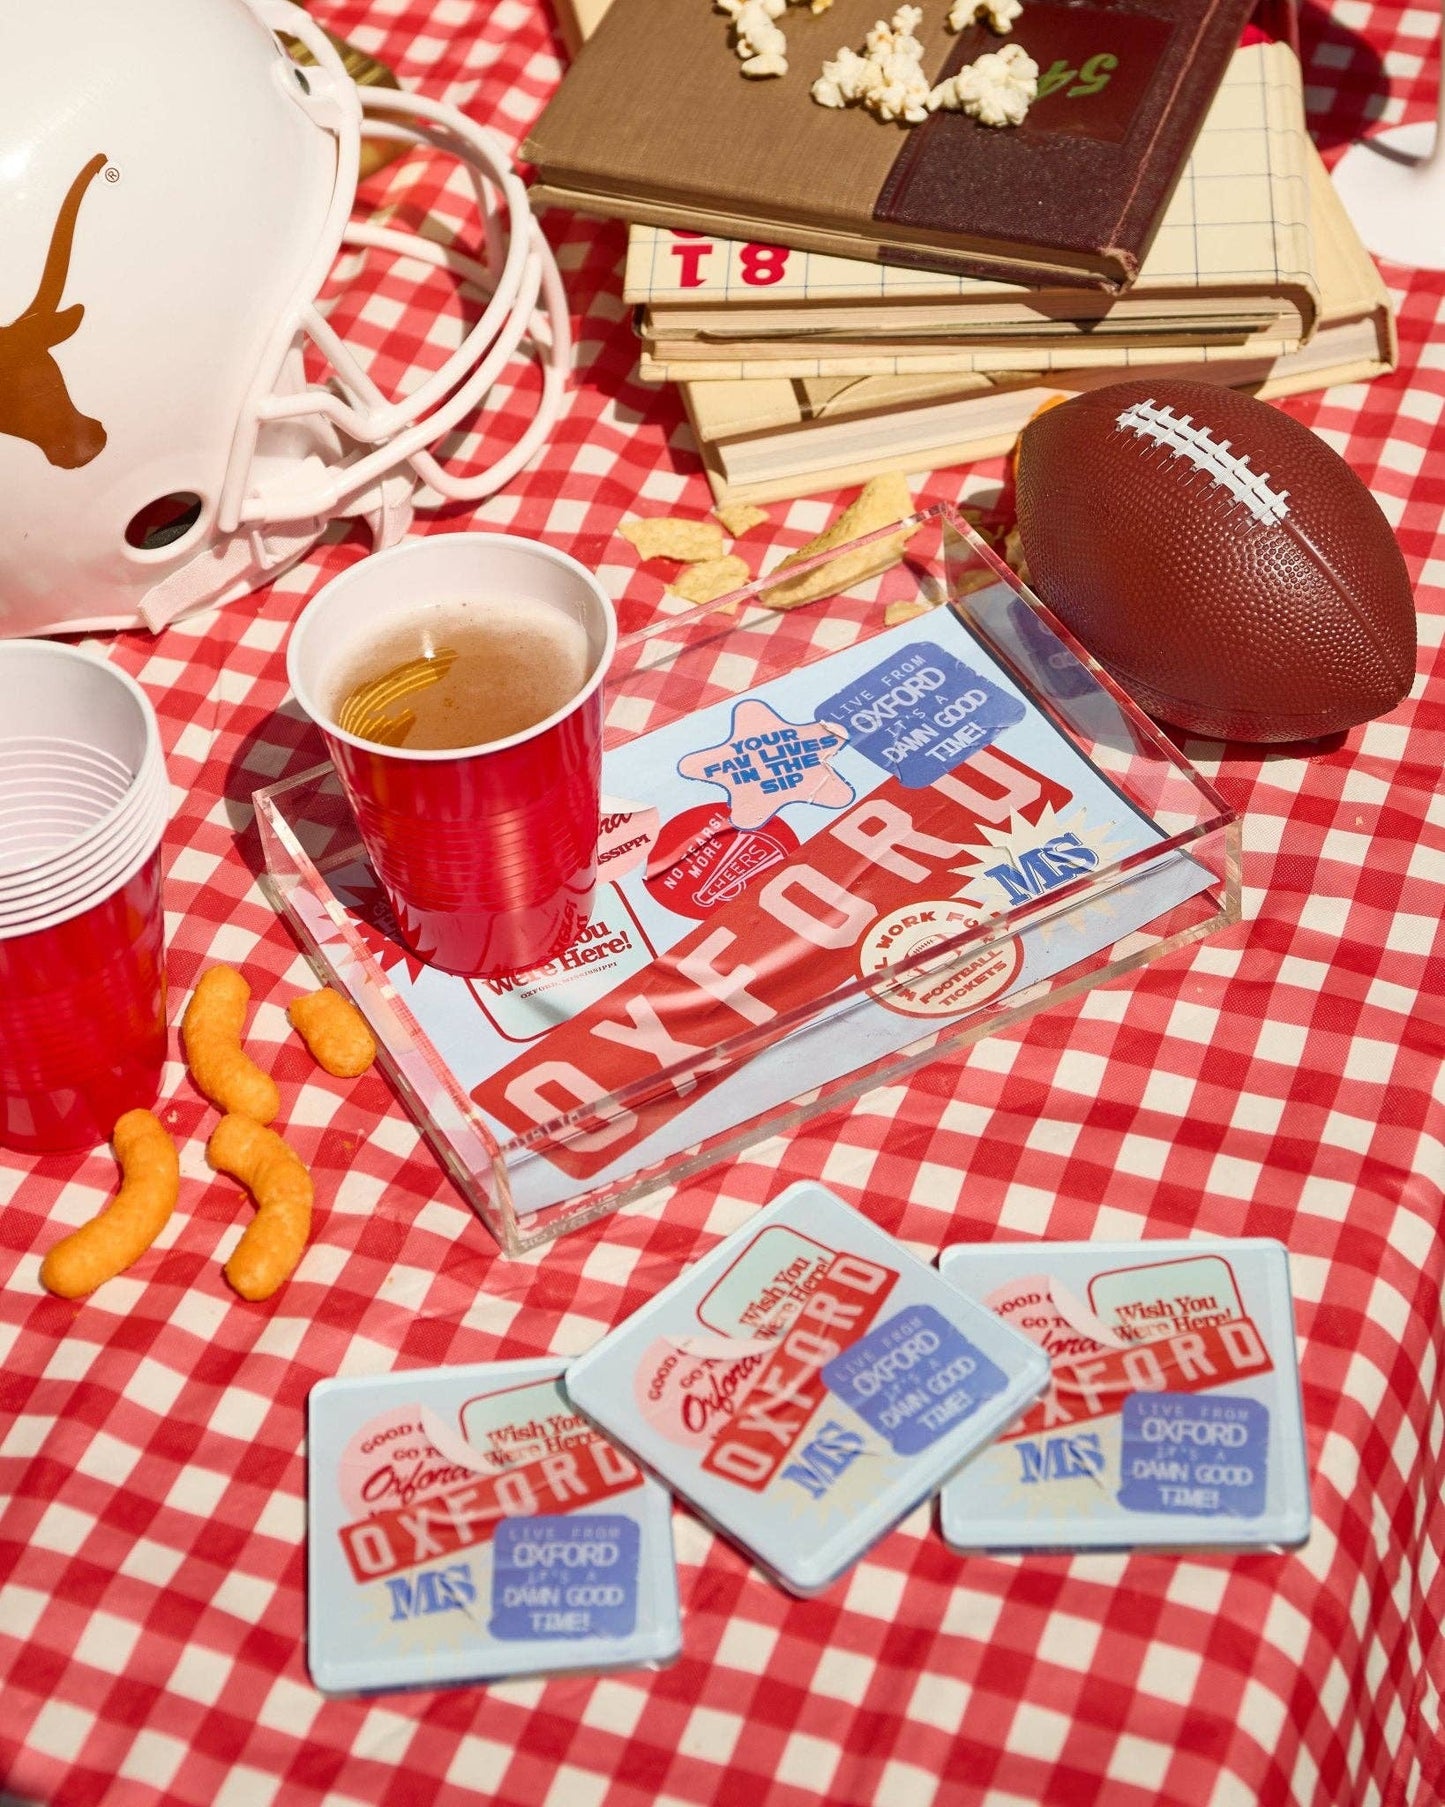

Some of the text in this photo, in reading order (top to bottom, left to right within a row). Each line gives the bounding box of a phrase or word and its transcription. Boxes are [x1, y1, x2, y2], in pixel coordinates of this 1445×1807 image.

[831, 654, 926, 720] LIVE FROM
[851, 667, 946, 733] OXFORD
[881, 689, 988, 763] DAMN GOOD
[886, 694, 949, 737] IT'S A
[703, 735, 839, 778] FAV LIVES
[731, 729, 799, 755] YOUR
[925, 722, 987, 762] TIME!
[731, 753, 821, 785] IN THE
[760, 773, 804, 794] SIP
[663, 812, 727, 890] NO TEARS!
[688, 838, 724, 879] MORE
[709, 845, 766, 897] CHEERS
[983, 832, 1099, 906] MS
[573, 920, 612, 946] ou
[875, 910, 936, 949] WORK
[558, 930, 633, 972] Here!
[919, 949, 1004, 1004] FOOTBALL
[939, 961, 1008, 1007] TICKETS
[739, 1257, 811, 1326] Wish You
[1114, 1295, 1218, 1323] Wish You
[1021, 1317, 1048, 1329] GO
[1172, 1307, 1232, 1332] Here!
[648, 1356, 678, 1400] GOOD
[680, 1369, 702, 1388] GO
[712, 1255, 888, 1483] OXFORD
[852, 1329, 940, 1396] OXFORD
[1009, 1323, 1267, 1434] XFORD
[879, 1356, 976, 1429] DAMN GOOD
[917, 1389, 974, 1431] TIME!
[1138, 1403, 1249, 1420] LIVE FROM
[361, 1424, 412, 1454] GOOD
[486, 1420, 546, 1447] Wish
[1141, 1418, 1248, 1447] OXFORD
[393, 1449, 420, 1461] GO
[782, 1420, 865, 1500] MS
[1015, 1433, 1106, 1485] MS
[1132, 1460, 1254, 1487] DAMN GOOD
[349, 1441, 638, 1575] OXFORD
[1159, 1488, 1220, 1508] TIME!
[508, 1526, 557, 1541] LIVE
[512, 1541, 620, 1569] OXFORD
[385, 1563, 477, 1621] MS
[503, 1586, 624, 1608] DAMN GOOD
[531, 1611, 590, 1632] TIME!
